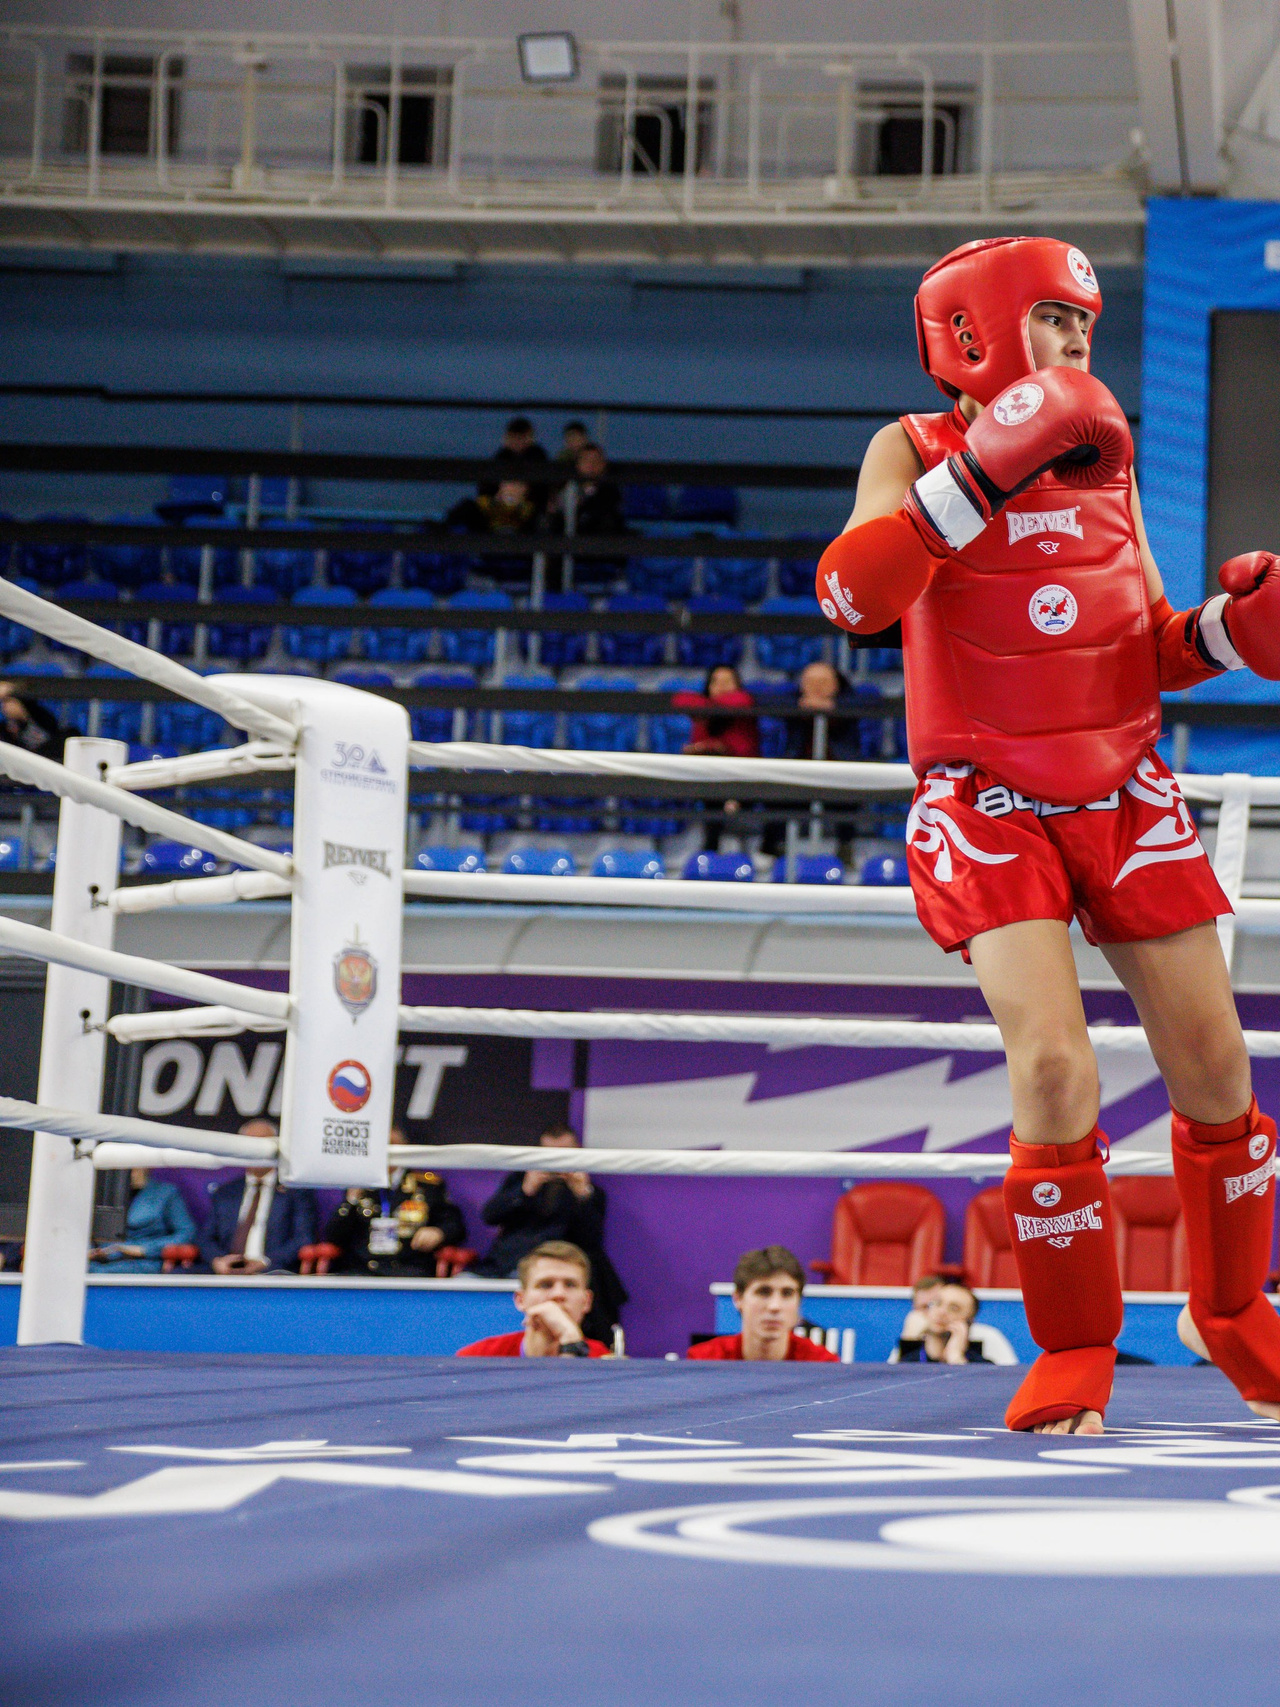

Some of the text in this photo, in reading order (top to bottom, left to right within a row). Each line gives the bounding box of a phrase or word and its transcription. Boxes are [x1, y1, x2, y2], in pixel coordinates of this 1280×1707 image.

[1005, 507, 1084, 546] REYVEL
[322, 840, 391, 880] REYVEL
[323, 1125, 370, 1139] СОЮЗ
